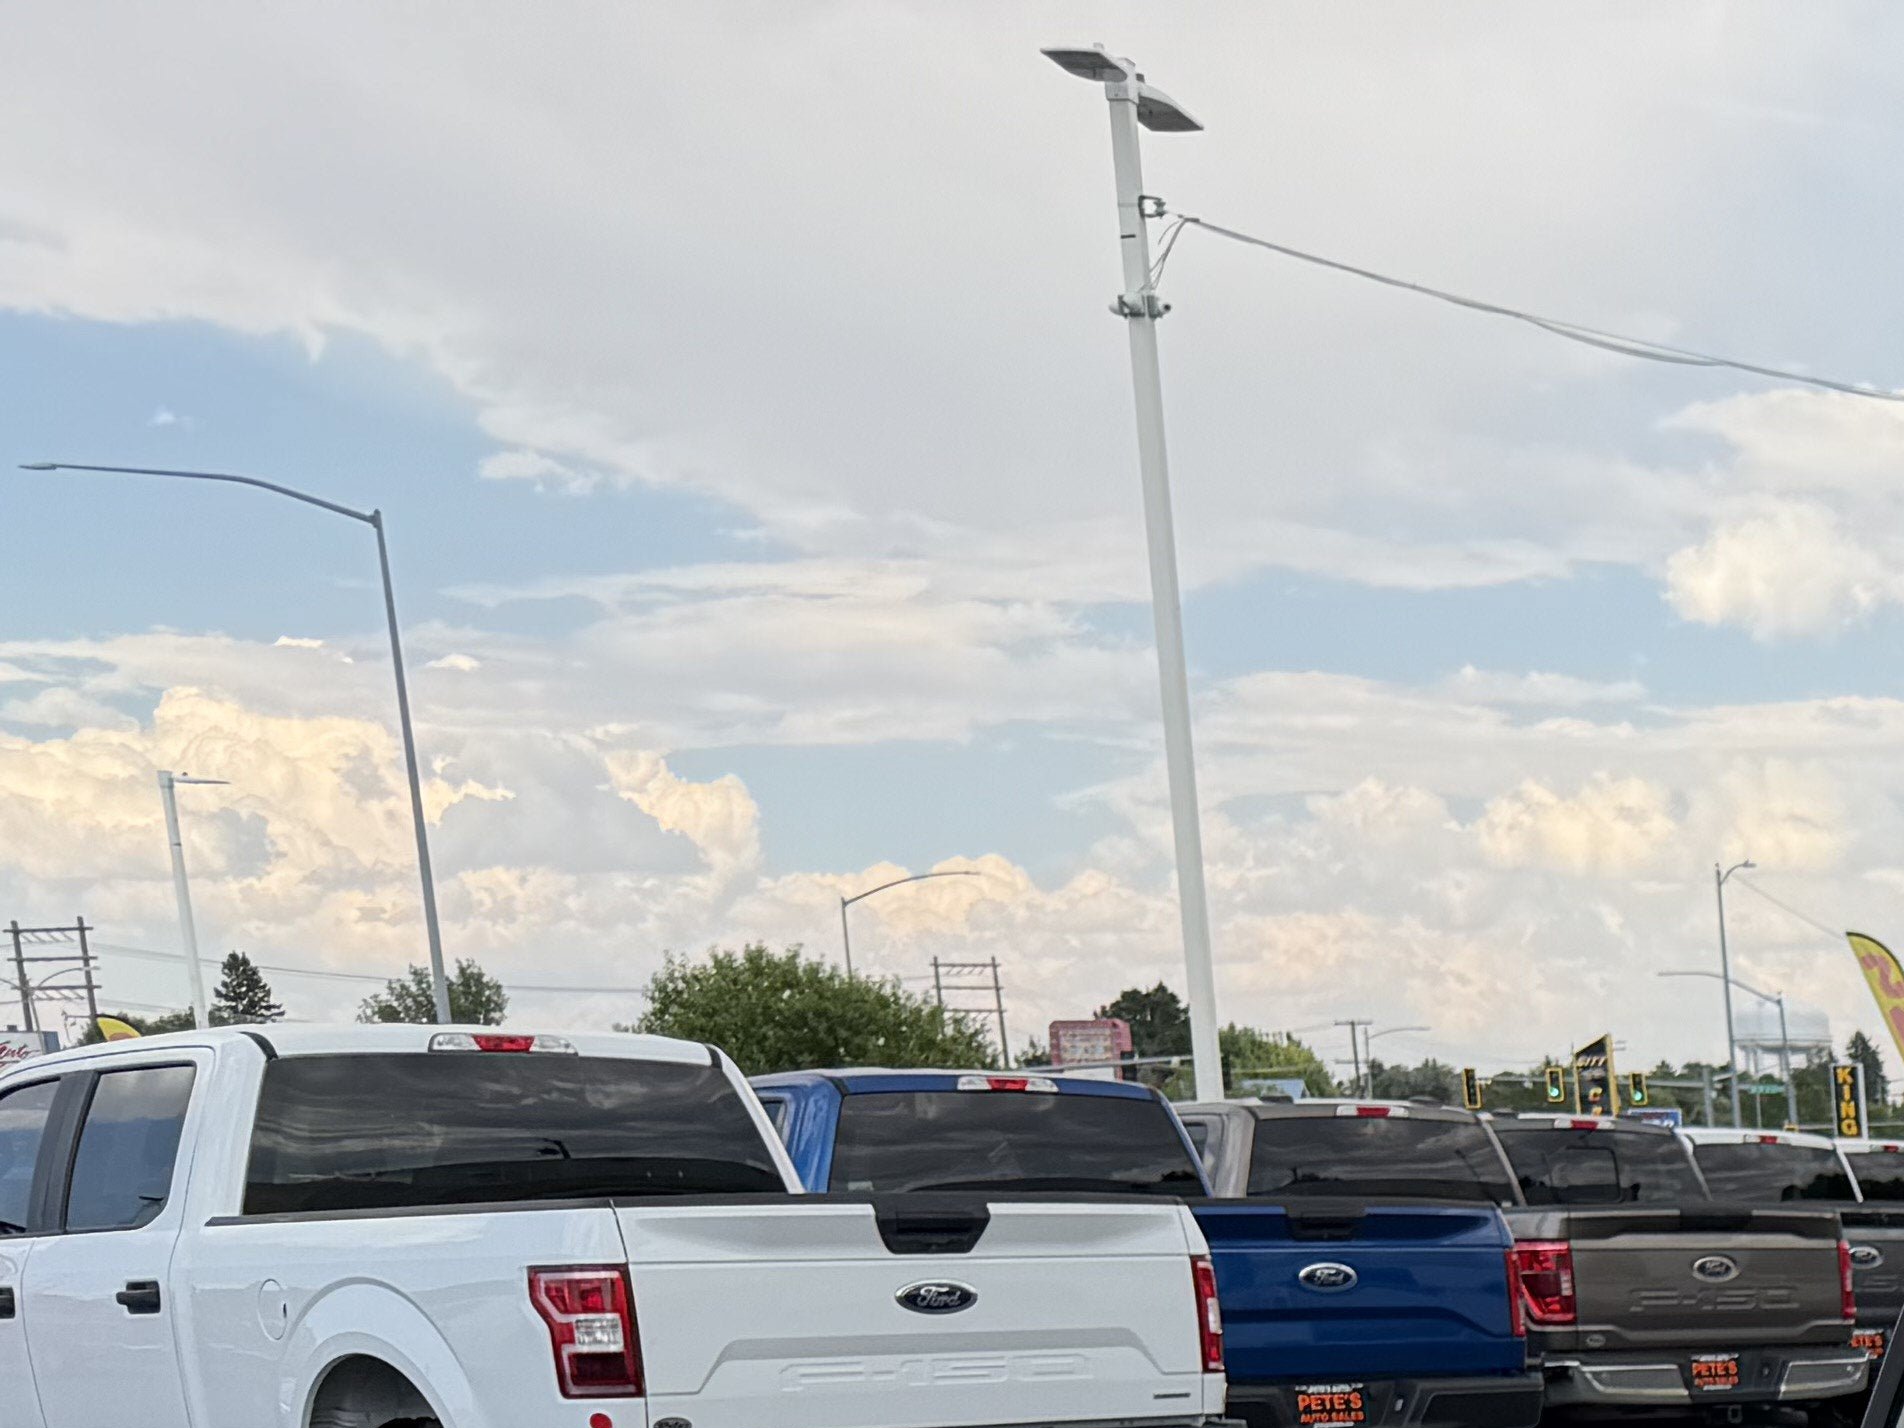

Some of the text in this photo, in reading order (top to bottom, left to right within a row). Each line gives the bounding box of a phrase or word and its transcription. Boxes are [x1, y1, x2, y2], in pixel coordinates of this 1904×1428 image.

[1836, 1067, 1858, 1136] KING
[917, 1286, 961, 1307] Ford
[1298, 1392, 1362, 1411] PETE'S
